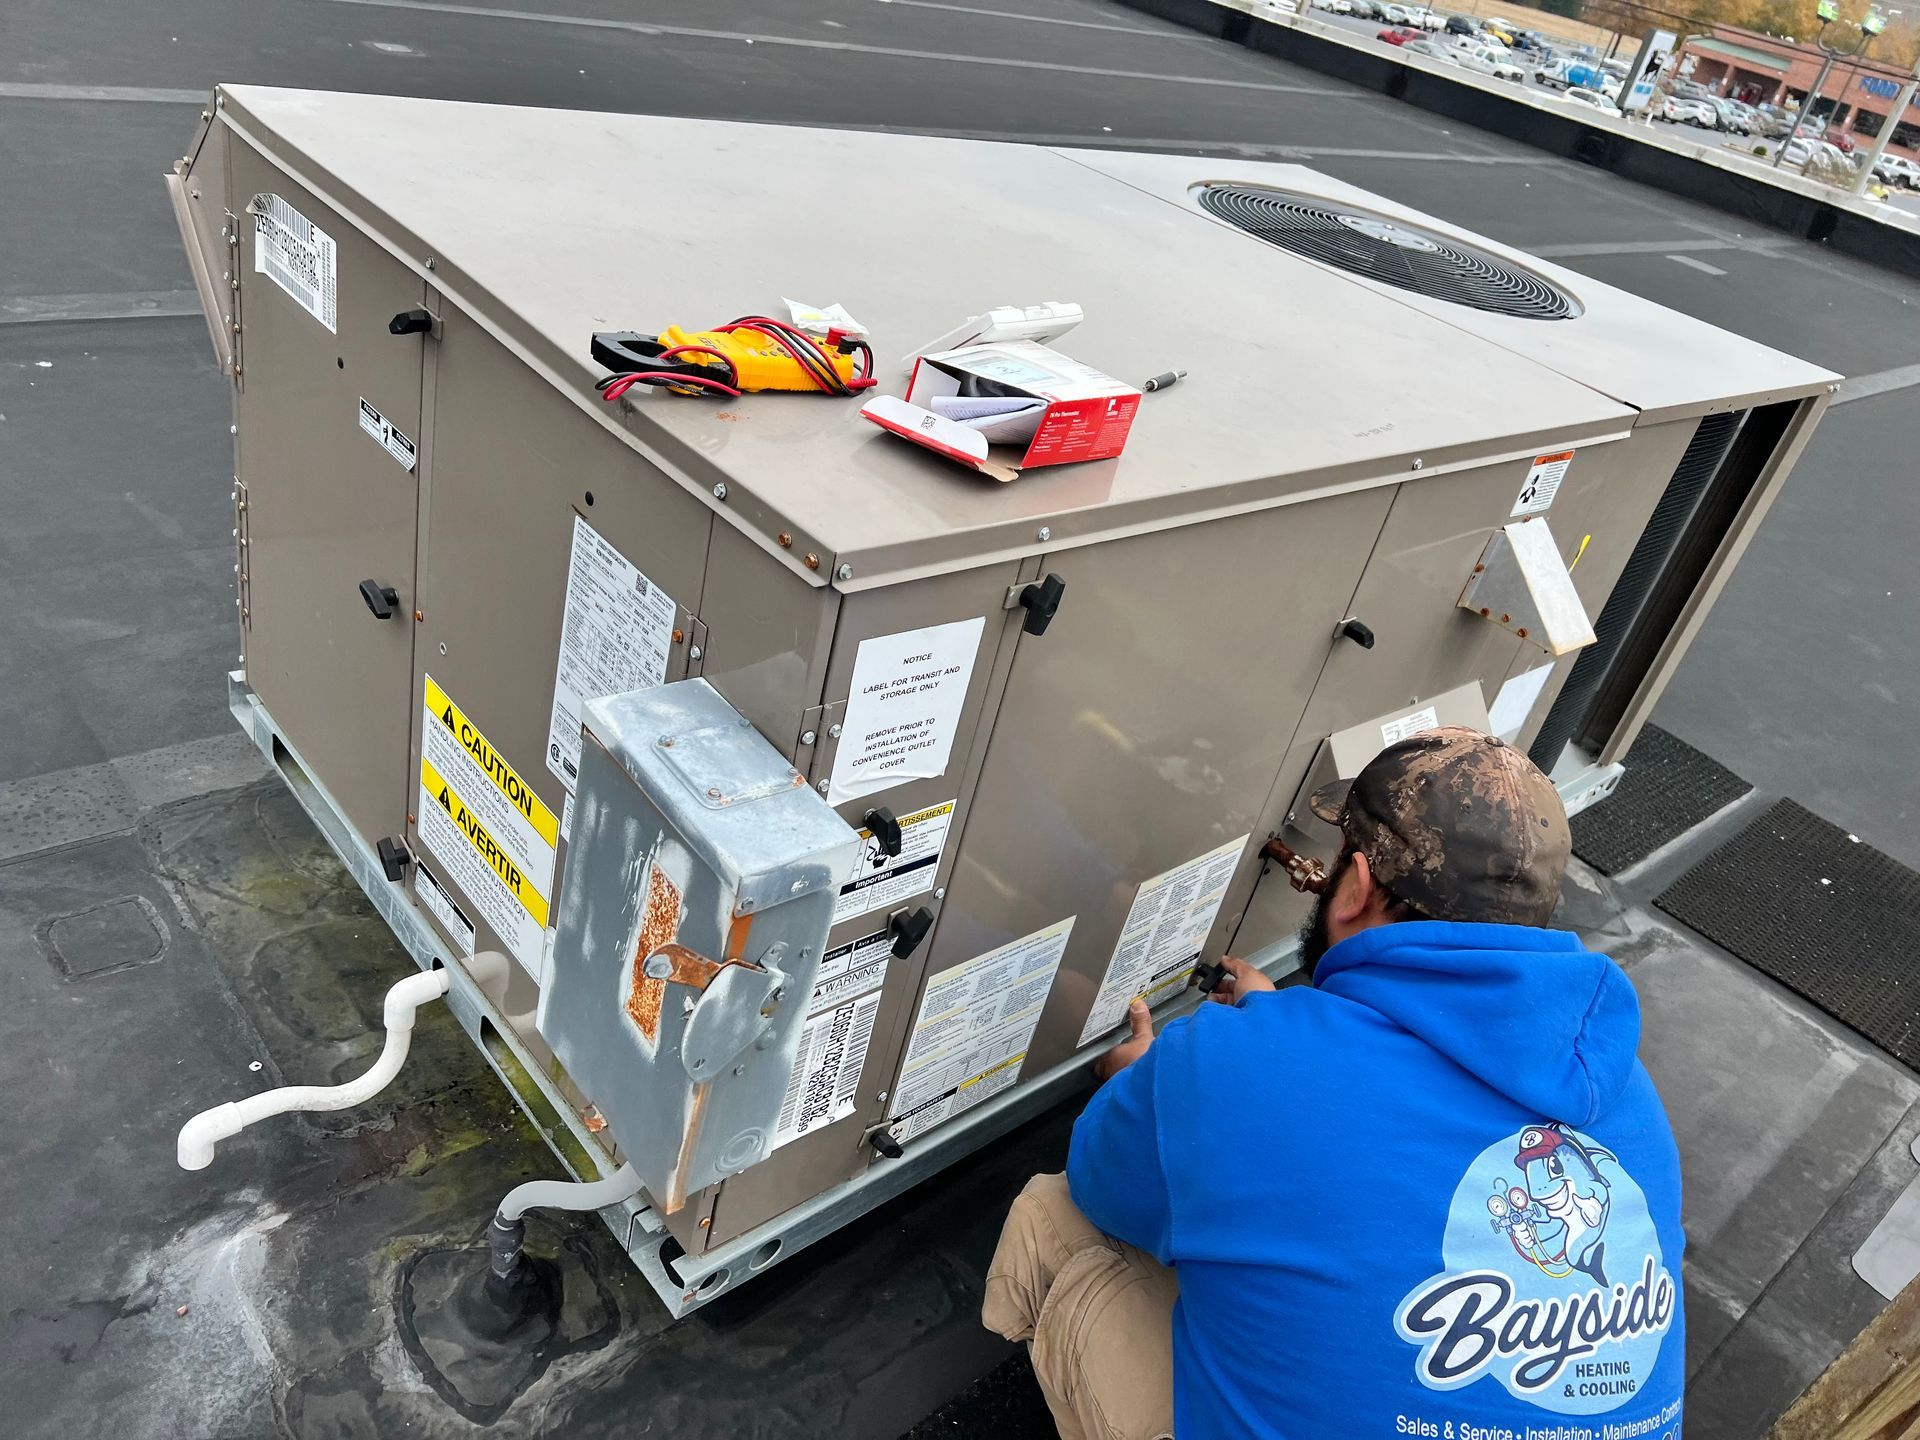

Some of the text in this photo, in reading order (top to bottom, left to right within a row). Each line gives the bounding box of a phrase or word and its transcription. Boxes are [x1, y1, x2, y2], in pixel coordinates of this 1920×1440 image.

[310, 224, 314, 242] E
[903, 653, 932, 665] NOTICE
[863, 666, 960, 694] LABEL FOR TRANSIT AND
[880, 681, 940, 701] STORAGE ONLY
[865, 727, 897, 741] REMOVE
[899, 722, 924, 732] PRIOR
[865, 730, 929, 752] INSTALLATION OF
[852, 739, 936, 766] CONVENIENCE OUTLET
[879, 758, 905, 769] COVER
[430, 716, 461, 758] HANDLING
[462, 753, 509, 813] INSTRUCTIONS
[461, 723, 532, 817] CAUTION
[426, 794, 468, 850] INSTRUCTIONS
[469, 847, 478, 863] DE
[480, 860, 525, 921] MANUTENTION
[457, 807, 521, 895] AVERTIR
[855, 871, 892, 889] Important
[826, 964, 879, 992] WARNING
[838, 1094, 853, 1107] E
[899, 1094, 945, 1120] FOR YOUR SAFETY
[1526, 1131, 1537, 1147] B
[1406, 1258, 1672, 1388] Bayside
[1575, 1360, 1631, 1378] HEATING
[1564, 1379, 1636, 1397] & COOLING
[1396, 1415, 1438, 1438] Sales
[1444, 1421, 1454, 1439] &
[1460, 1423, 1513, 1440] Service
[1526, 1426, 1591, 1440] Installation
[1603, 1414, 1660, 1440] Maintenance
